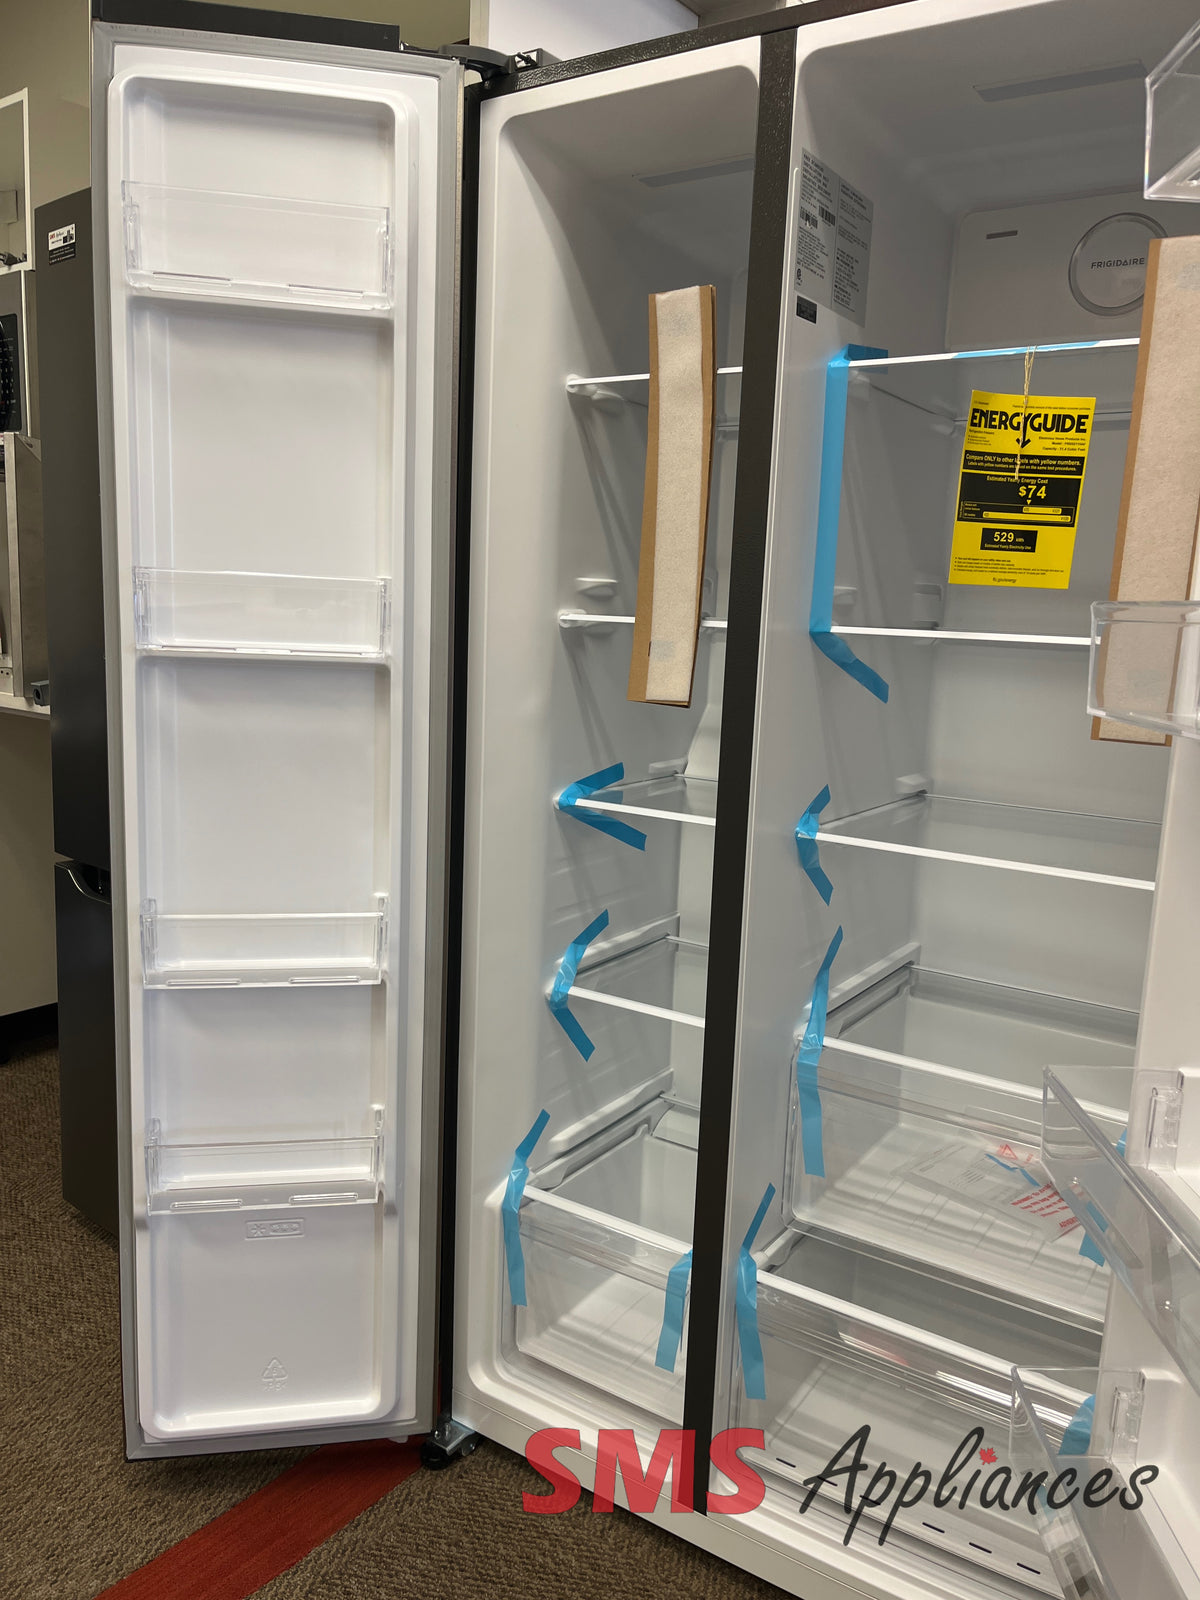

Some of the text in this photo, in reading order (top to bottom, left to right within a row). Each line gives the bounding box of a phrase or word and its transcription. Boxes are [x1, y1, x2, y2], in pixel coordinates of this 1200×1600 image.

[1090, 257, 1145, 269] FRIGIDAIRE
[970, 408, 1089, 434] ENERGYGUIDE
[1018, 485, 1047, 499] $74
[993, 531, 1014, 542] 529
